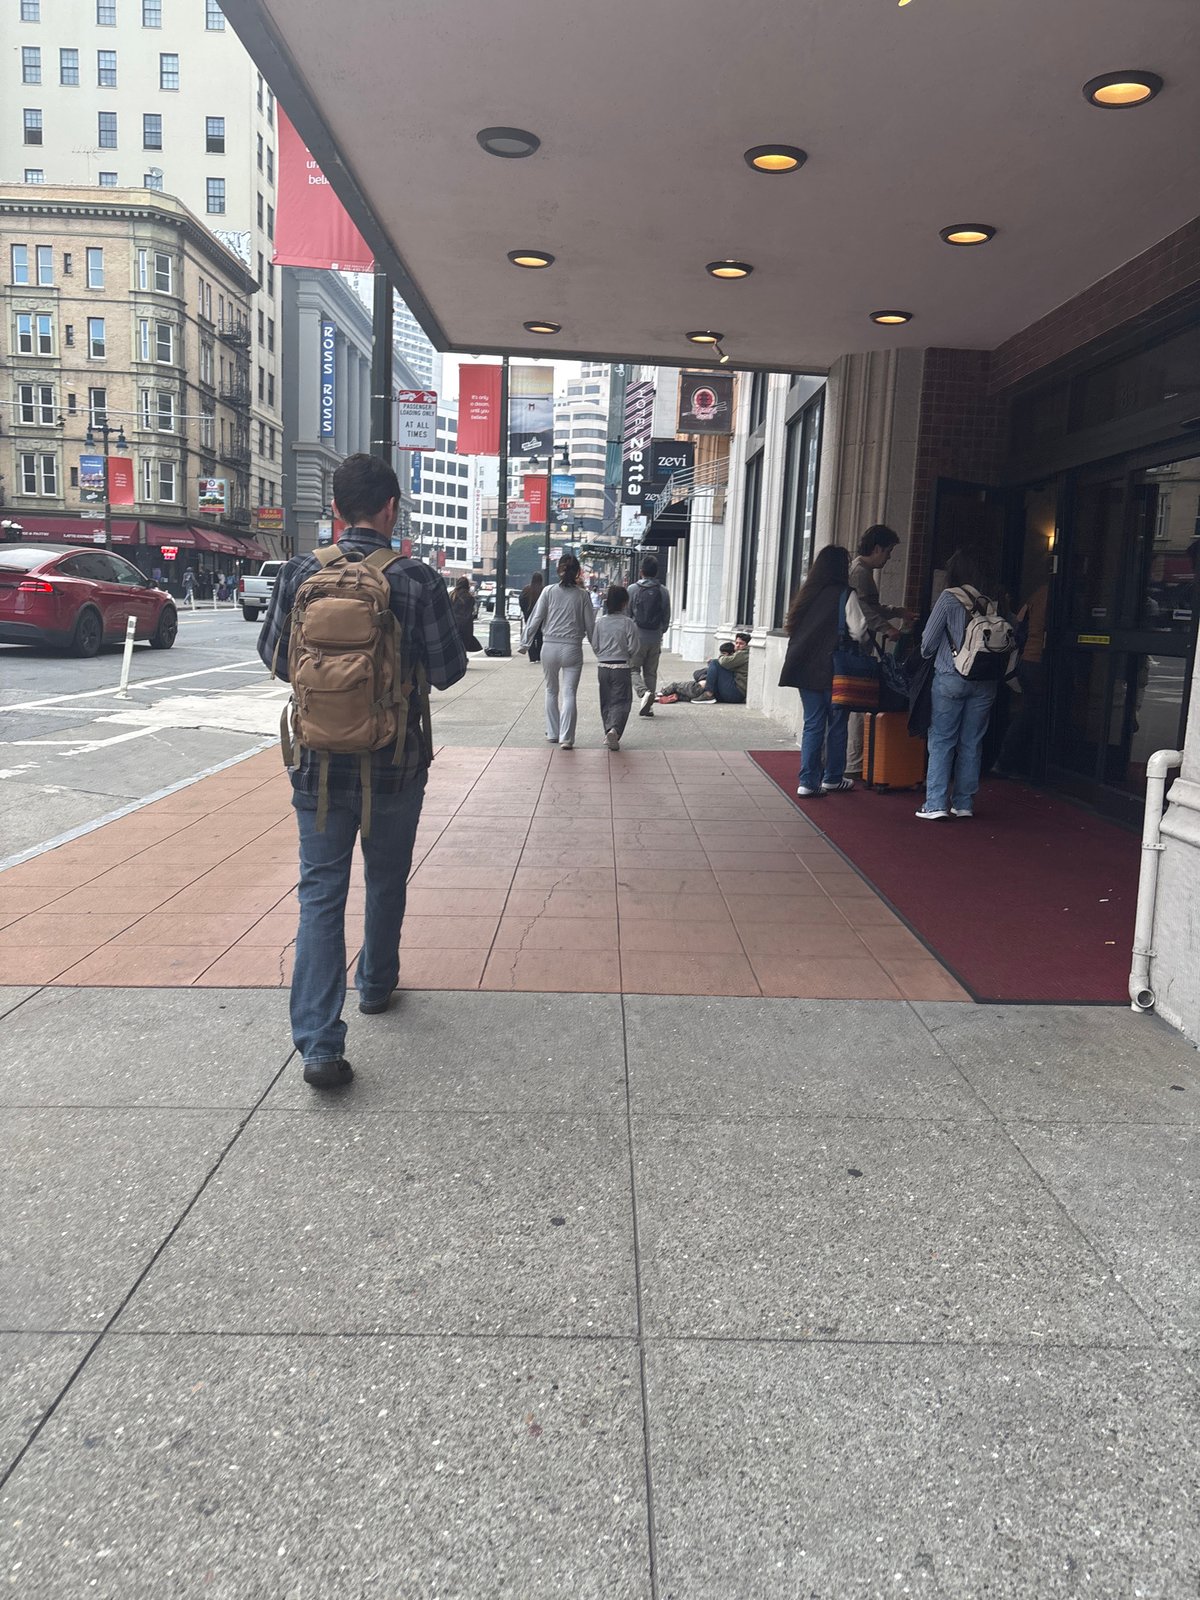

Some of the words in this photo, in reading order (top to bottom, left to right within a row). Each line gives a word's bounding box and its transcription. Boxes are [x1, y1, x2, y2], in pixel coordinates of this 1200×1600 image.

[323, 326, 334, 374] ROSS
[322, 384, 333, 431] ROSS
[634, 389, 646, 434] HOTEL
[407, 430, 428, 438] TIMES
[627, 437, 645, 496] zetta
[658, 454, 687, 467] zevi
[610, 547, 632, 555] zetta
